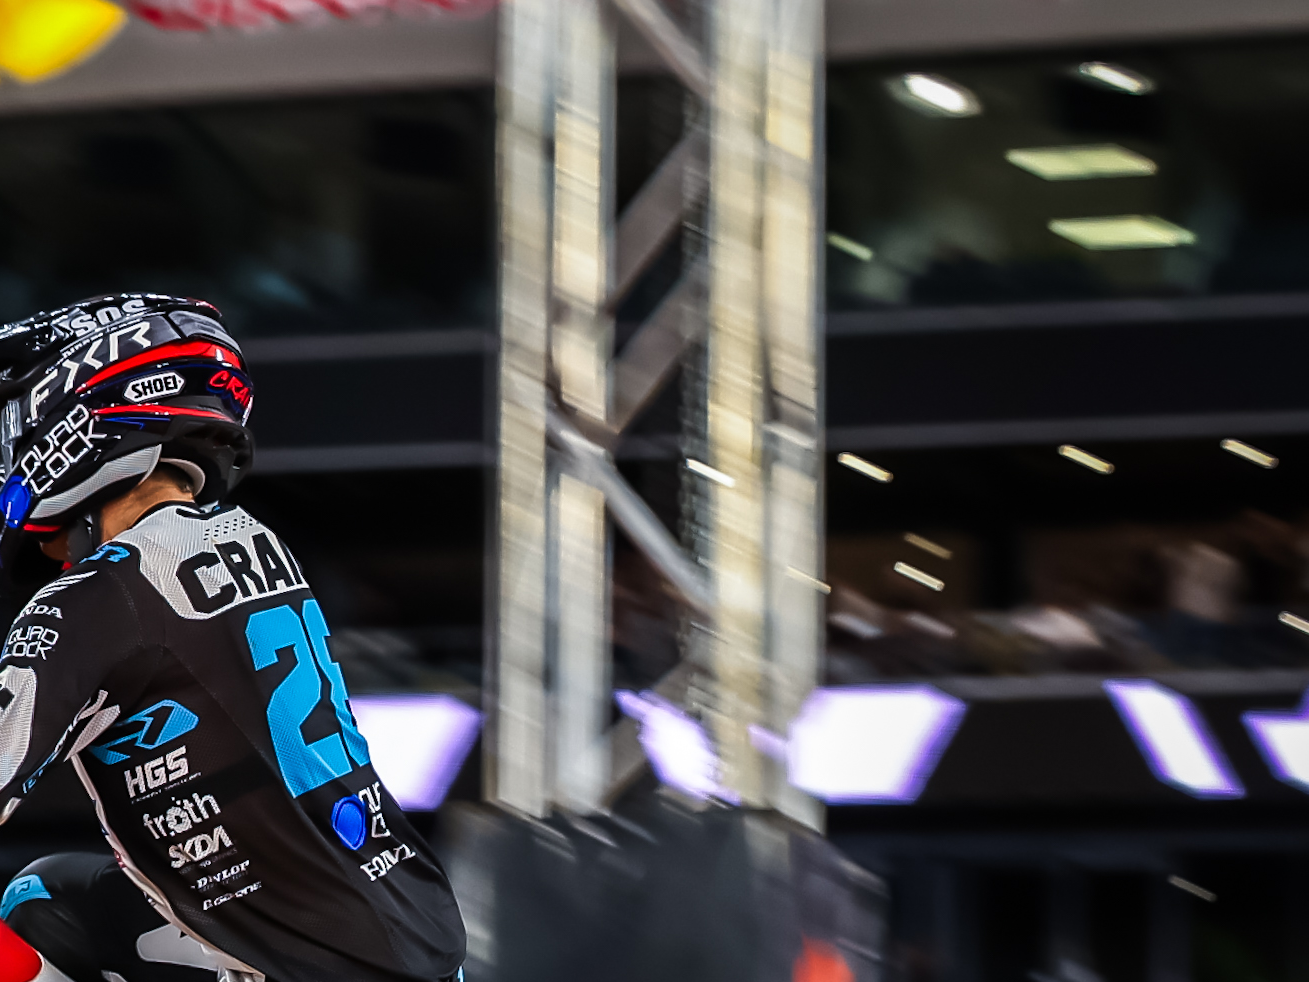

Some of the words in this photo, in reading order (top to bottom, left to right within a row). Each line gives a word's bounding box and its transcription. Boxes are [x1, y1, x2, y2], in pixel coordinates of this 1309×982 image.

[30, 321, 151, 420] FXR
[131, 375, 178, 399] SHOEI
[21, 404, 89, 486] QUAD
[29, 419, 107, 494] LOCK
[8, 625, 59, 646] QUAD
[124, 745, 189, 798] HGS
